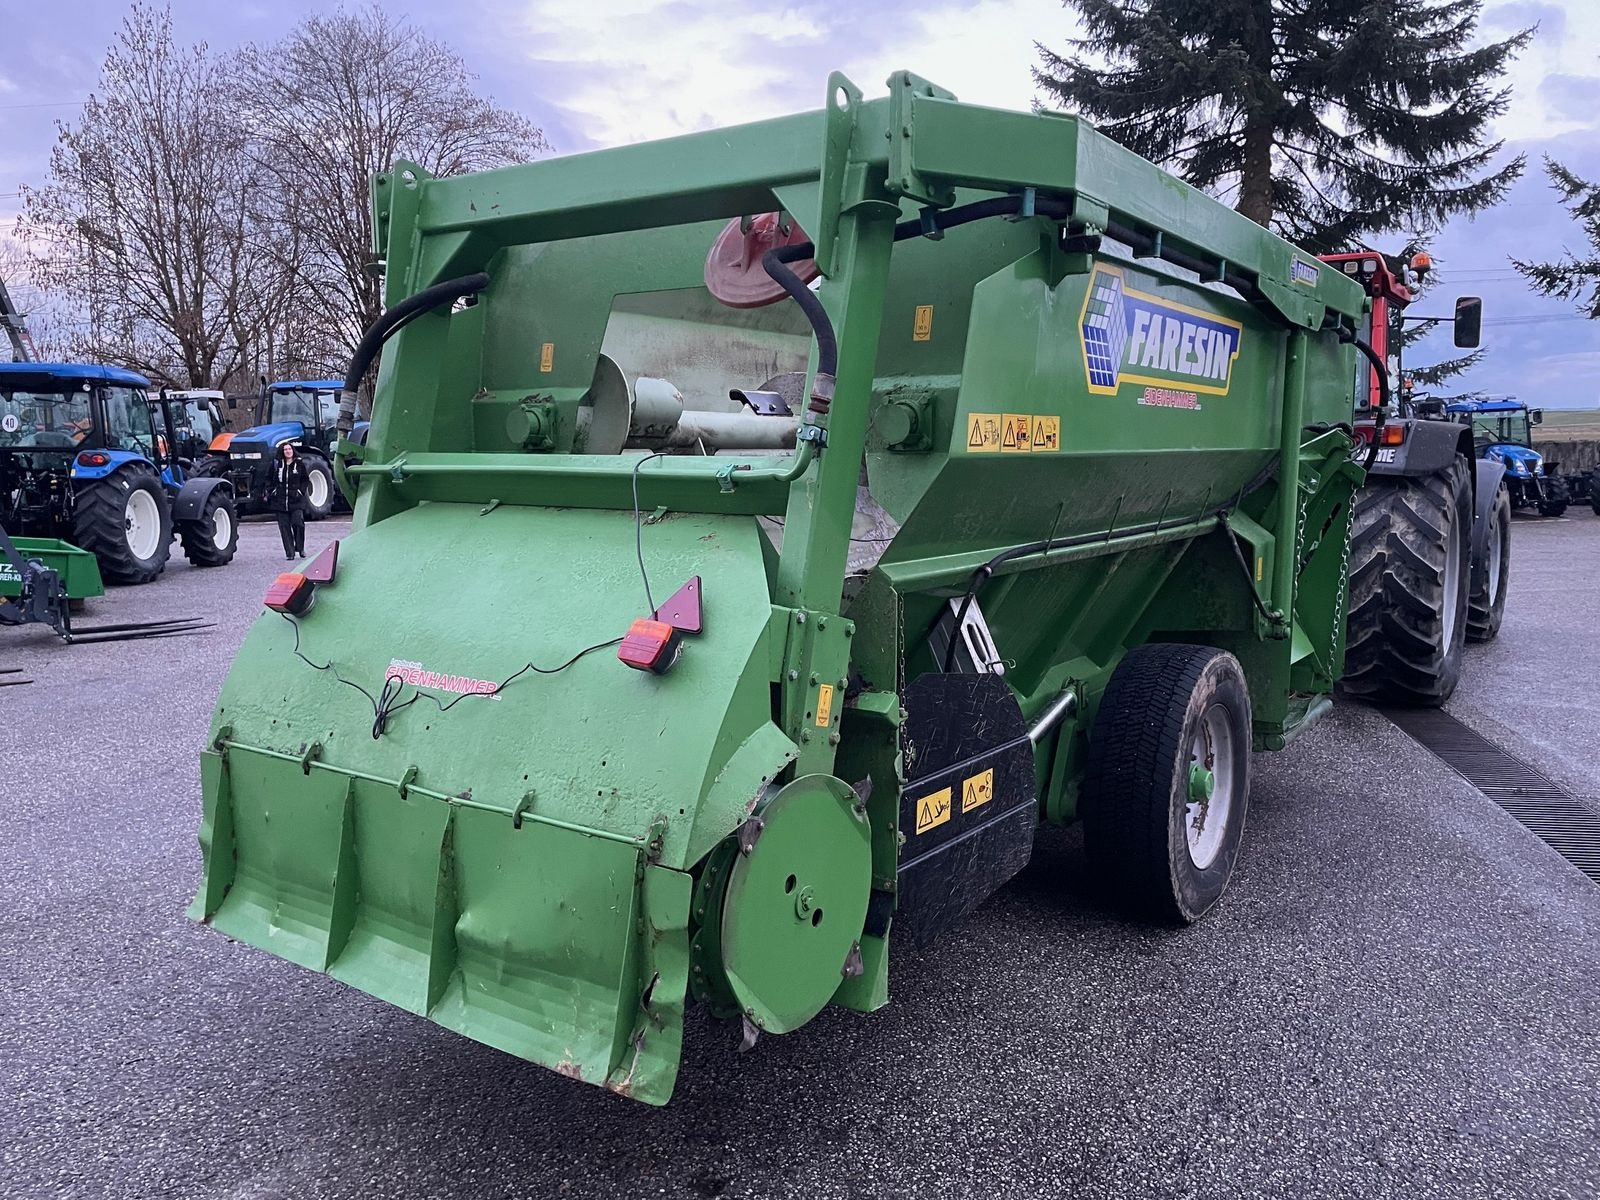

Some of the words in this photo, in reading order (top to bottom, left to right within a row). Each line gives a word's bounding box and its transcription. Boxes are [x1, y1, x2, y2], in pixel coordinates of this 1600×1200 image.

[1128, 309, 1232, 381] FARESIN
[5, 417, 15, 428] 40
[385, 665, 498, 698] EIDENHAMMER
